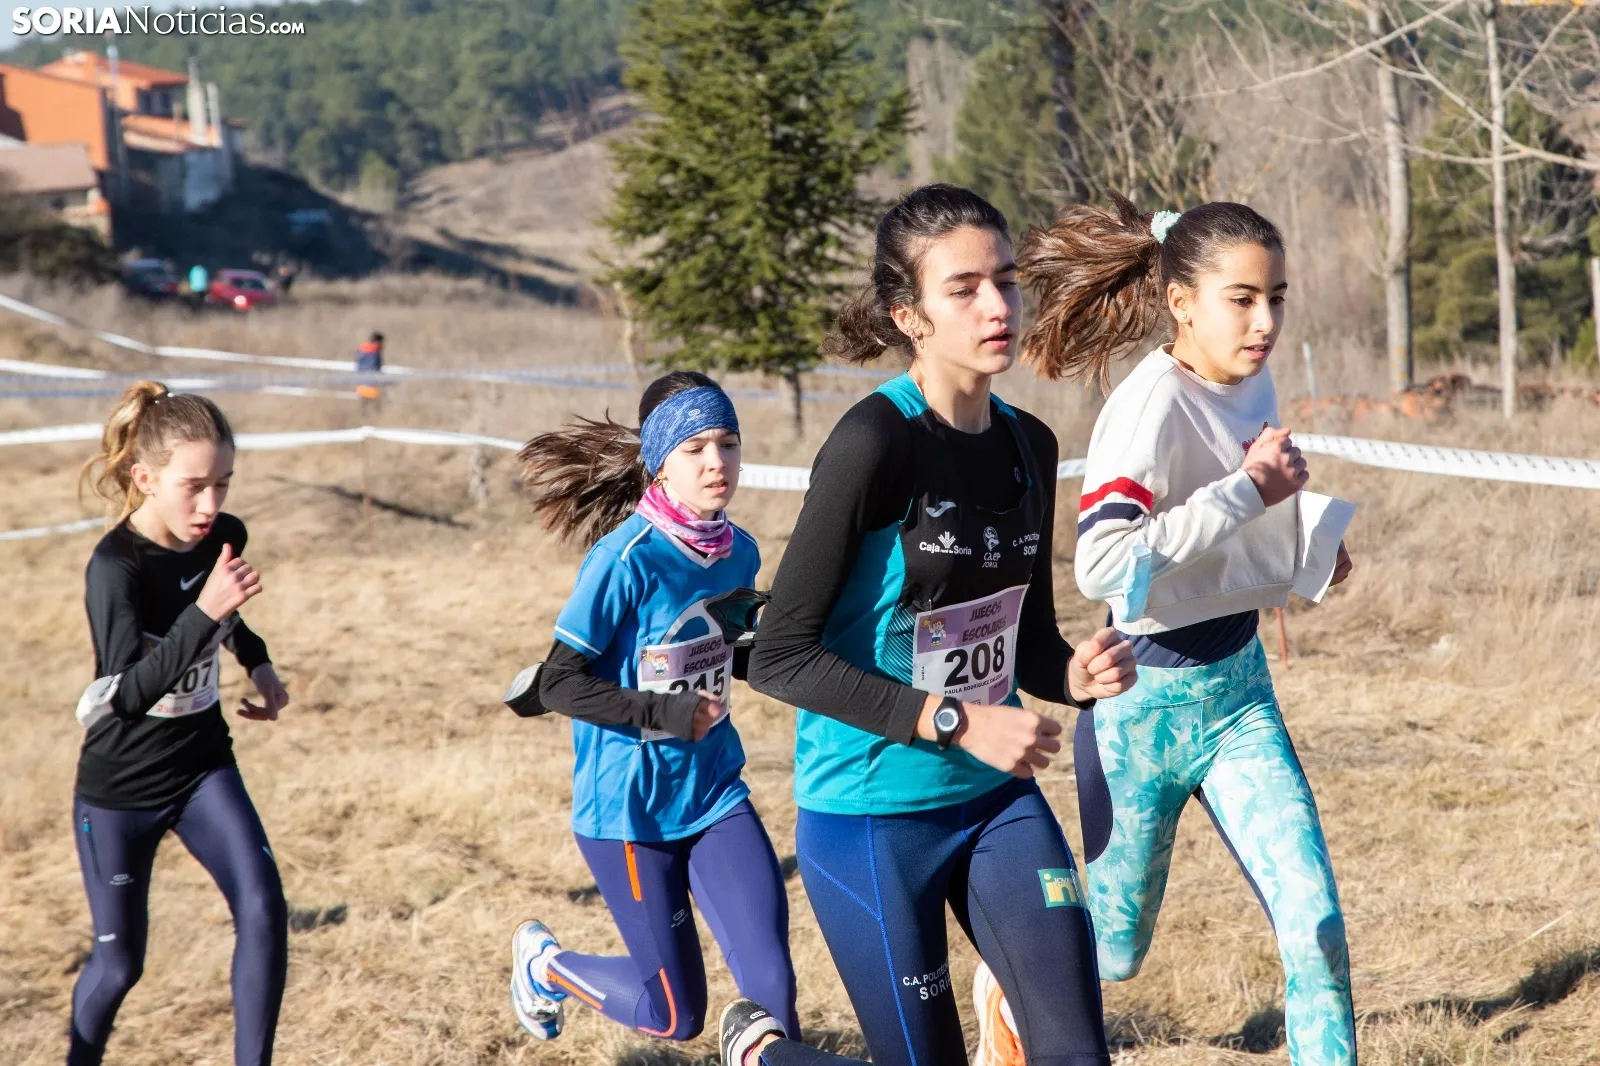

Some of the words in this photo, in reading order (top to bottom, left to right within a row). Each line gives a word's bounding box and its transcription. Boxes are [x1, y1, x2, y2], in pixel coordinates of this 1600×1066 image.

[919, 541, 940, 554] Caja
[953, 544, 972, 555] Soria
[968, 599, 1002, 622] JUEGOS
[961, 612, 1007, 643] ESCOLARES
[688, 638, 722, 658] JUEGOS
[683, 650, 727, 674] ESCOLARES
[943, 634, 1005, 688] 208
[172, 659, 213, 694] 07
[944, 687, 963, 696] PAULA
[902, 976, 922, 986] C.A.
